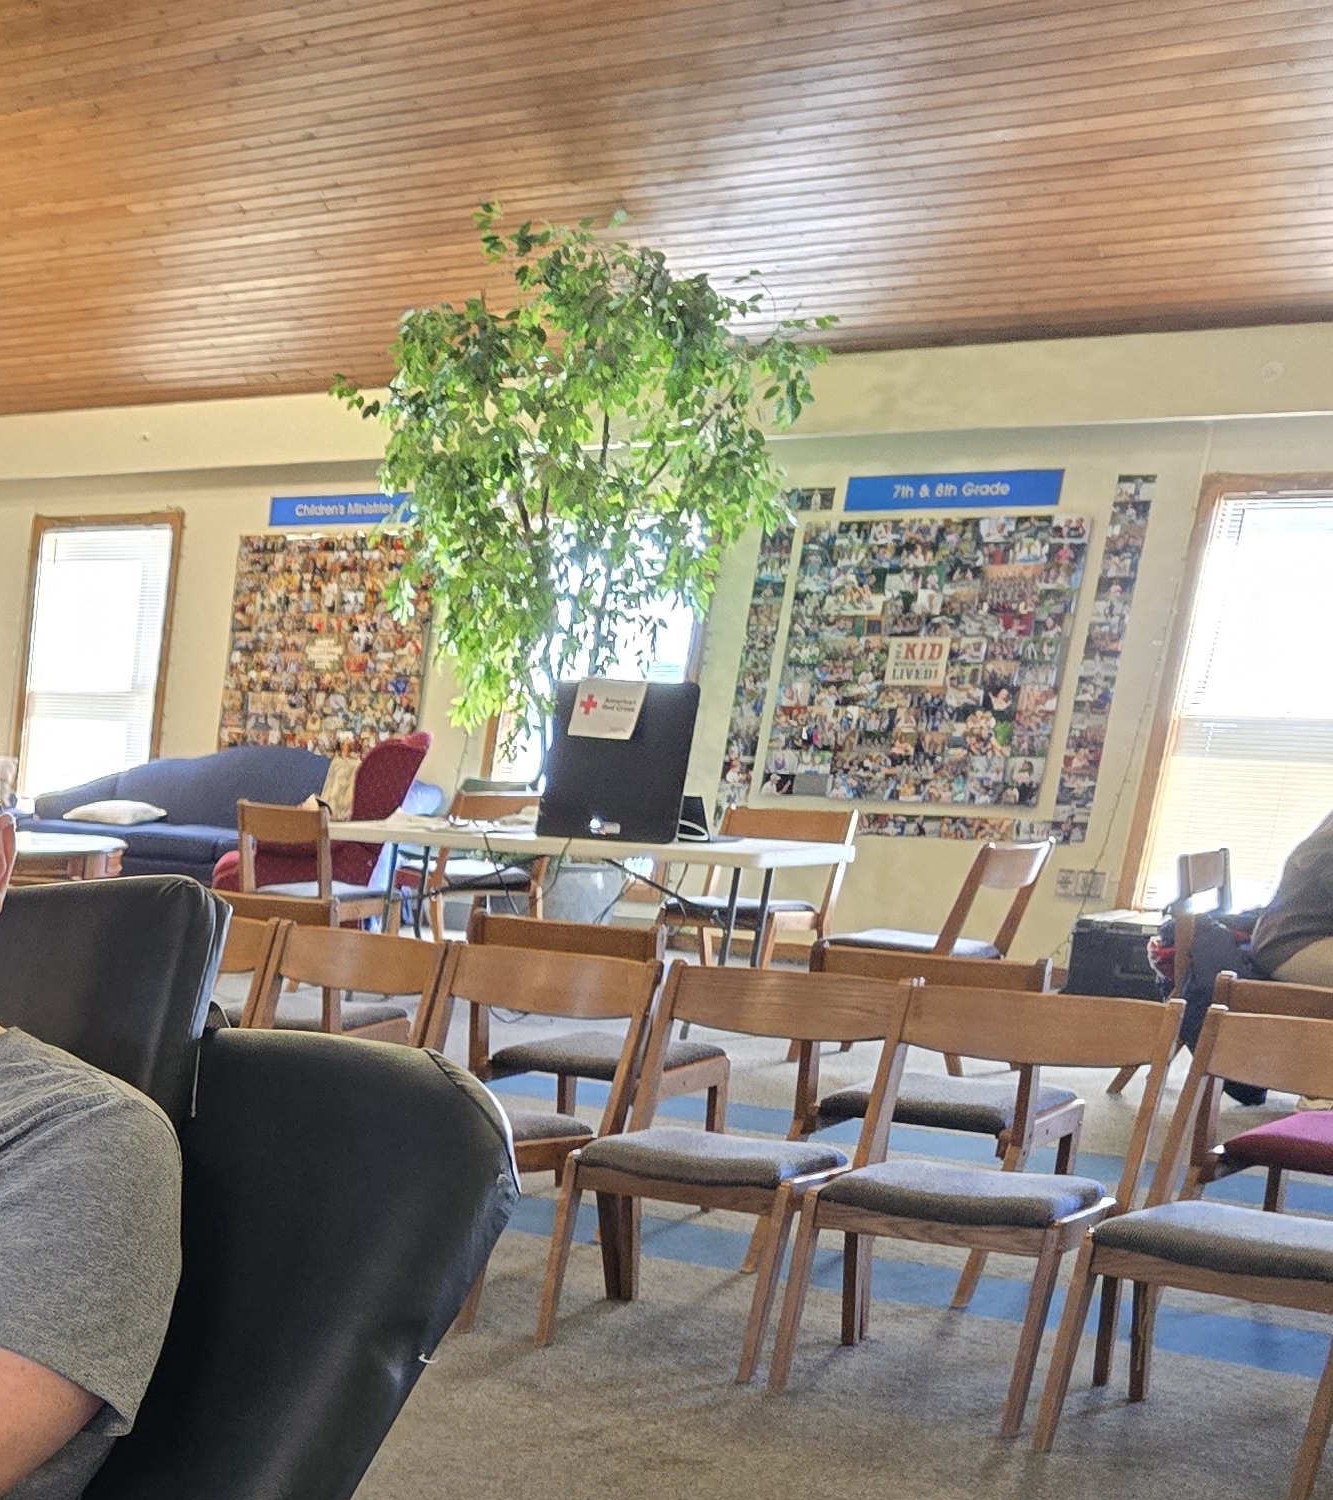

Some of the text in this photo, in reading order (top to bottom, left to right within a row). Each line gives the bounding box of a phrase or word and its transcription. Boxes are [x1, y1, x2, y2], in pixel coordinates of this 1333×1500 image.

[892, 480, 1011, 499] 7th & 8th Grade
[295, 503, 346, 517] Children's
[904, 642, 944, 661] KID
[891, 668, 939, 681] LIVED!
